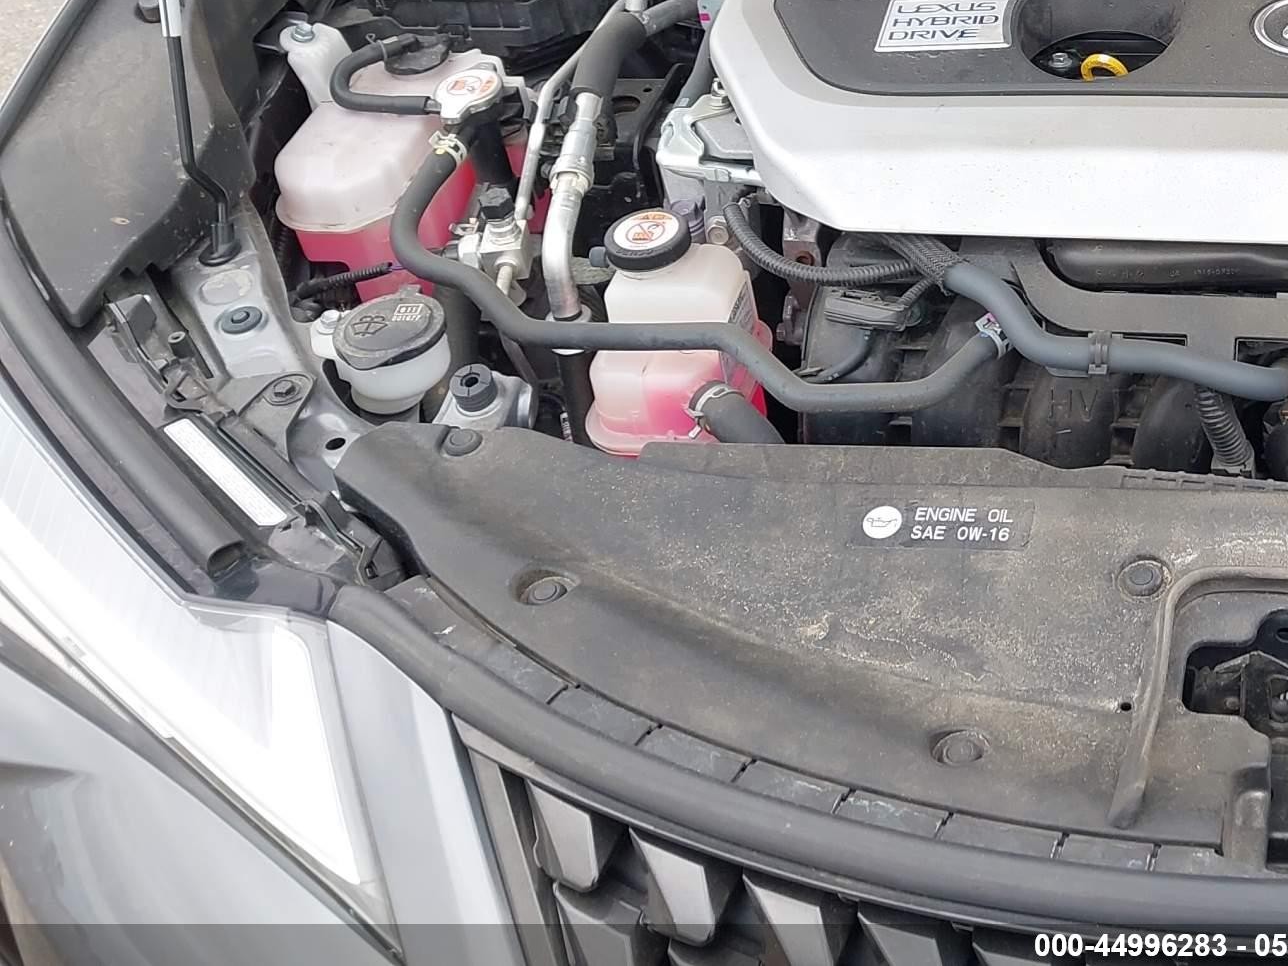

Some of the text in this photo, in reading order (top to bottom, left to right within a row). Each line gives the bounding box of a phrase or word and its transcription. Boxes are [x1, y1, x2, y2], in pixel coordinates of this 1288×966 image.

[897, 2, 997, 13] LEXUS
[892, 14, 999, 27] HYBRID
[888, 28, 980, 41] DRIVE
[914, 507, 1013, 523] ENGINE OIL
[910, 525, 1010, 541] SAE 0W-16
